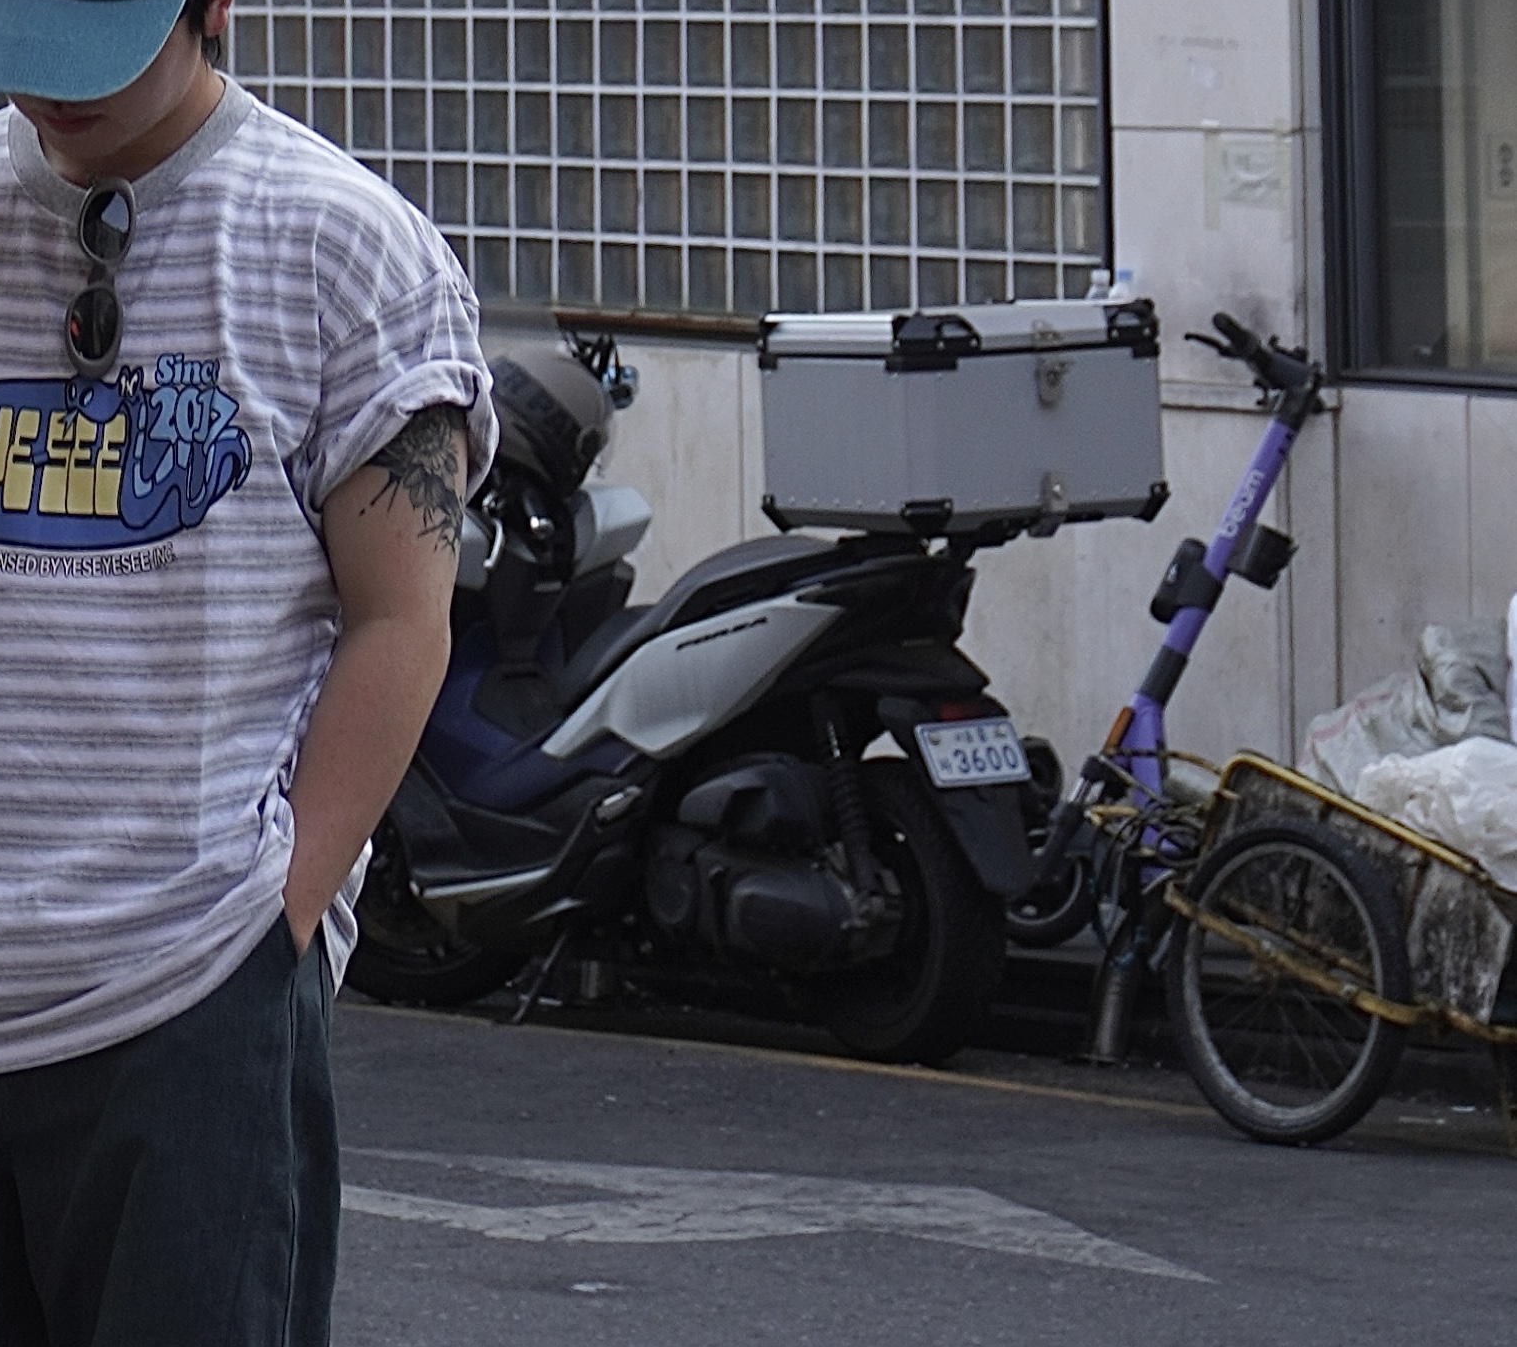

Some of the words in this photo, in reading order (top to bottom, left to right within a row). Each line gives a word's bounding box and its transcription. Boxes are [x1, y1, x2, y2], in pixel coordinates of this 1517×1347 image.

[1220, 468, 1266, 540] beam
[39, 555, 61, 578] BY
[62, 551, 152, 578] YESEYESEE
[953, 746, 1019, 774] 3600
